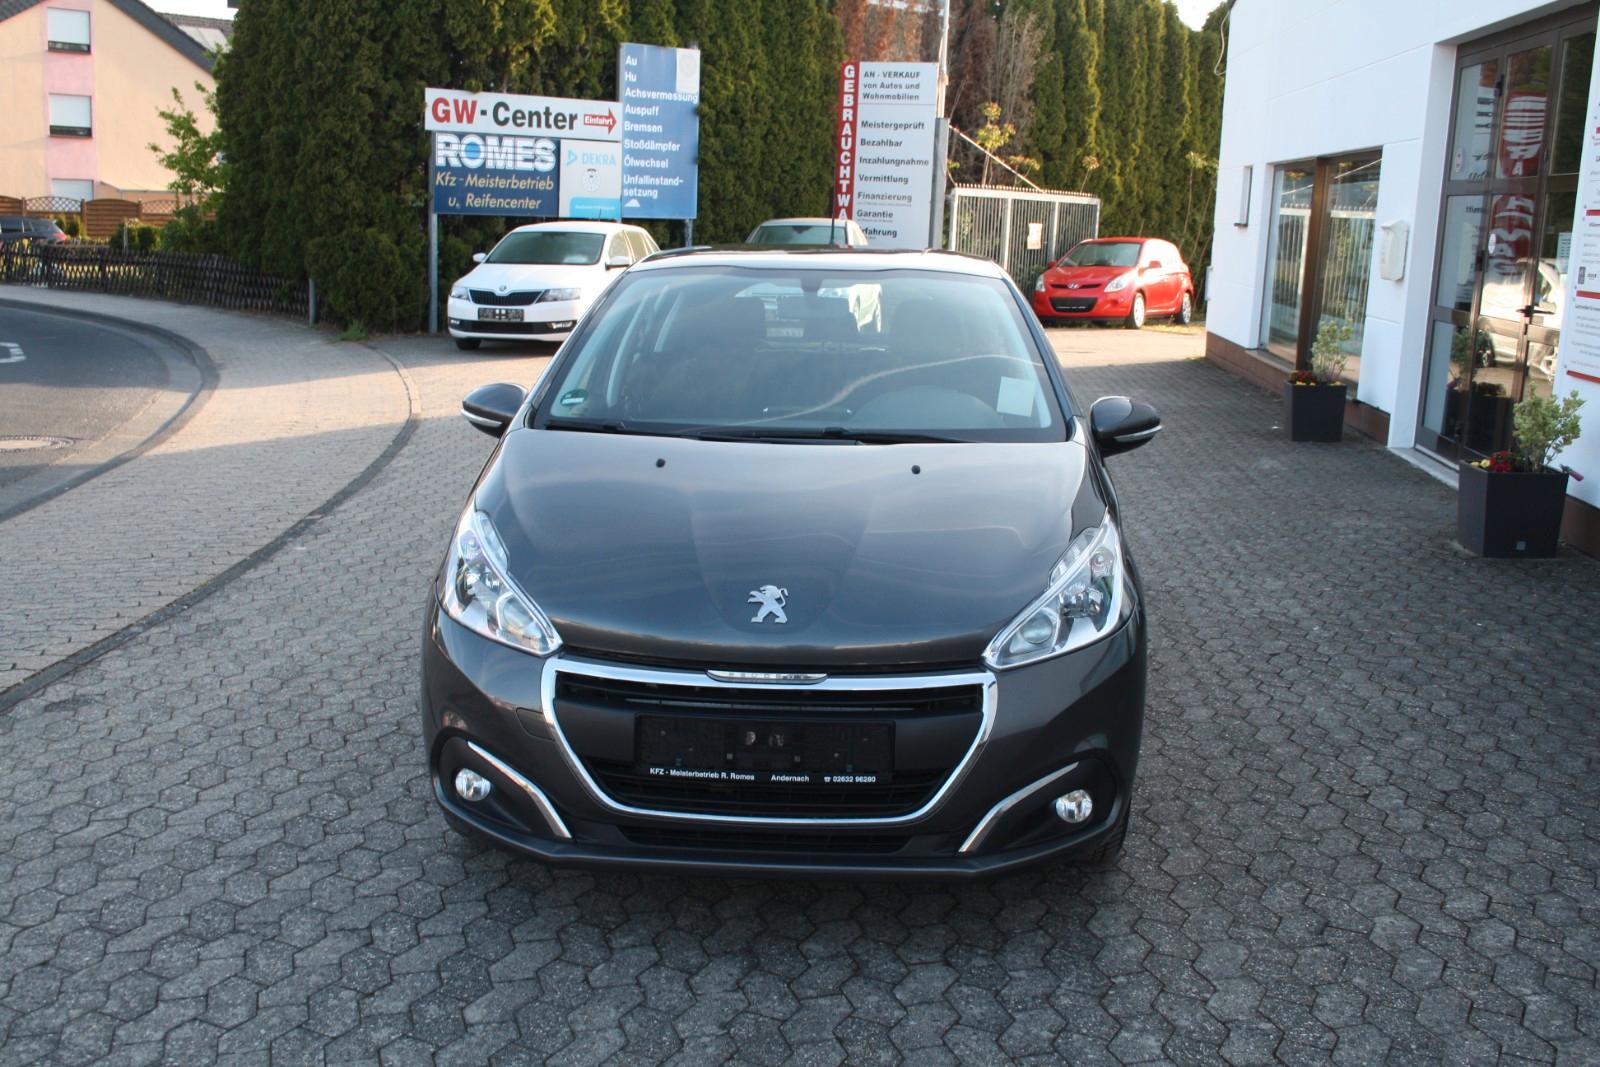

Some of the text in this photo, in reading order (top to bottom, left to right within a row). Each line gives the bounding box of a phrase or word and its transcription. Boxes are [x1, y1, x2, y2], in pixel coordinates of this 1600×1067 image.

[625, 55, 638, 66] Au
[625, 71, 637, 82] Hu
[882, 71, 921, 79] VERKAUF
[880, 82, 903, 90] Autos
[624, 87, 699, 104] Achsvermessung
[863, 92, 920, 101] Wohnmobilien
[624, 104, 660, 117] Auspuff
[584, 115, 614, 126] Einfahrt
[861, 120, 926, 131] Meistergeprüft
[624, 121, 663, 133] Bremsen
[623, 138, 681, 152] Stoßdämpfer
[860, 138, 903, 147] Bezahlbar
[435, 132, 557, 172] ROMES
[581, 151, 617, 166] DEKRA
[623, 154, 669, 169] Ölwechsel
[859, 156, 930, 167] Inzahlungnahme
[858, 174, 909, 185] Vermittlung
[623, 187, 658, 200] setzung
[857, 191, 913, 203] Finanzierung
[447, 194, 542, 210] u. Reifencenter
[856, 209, 894, 218] Garantie
[860, 226, 898, 239] rfahrung
[649, 767, 664, 775] KFZ
[670, 769, 720, 779] Meisterbetrieb
[730, 772, 755, 780] Romes
[771, 774, 810, 782] Andernach
